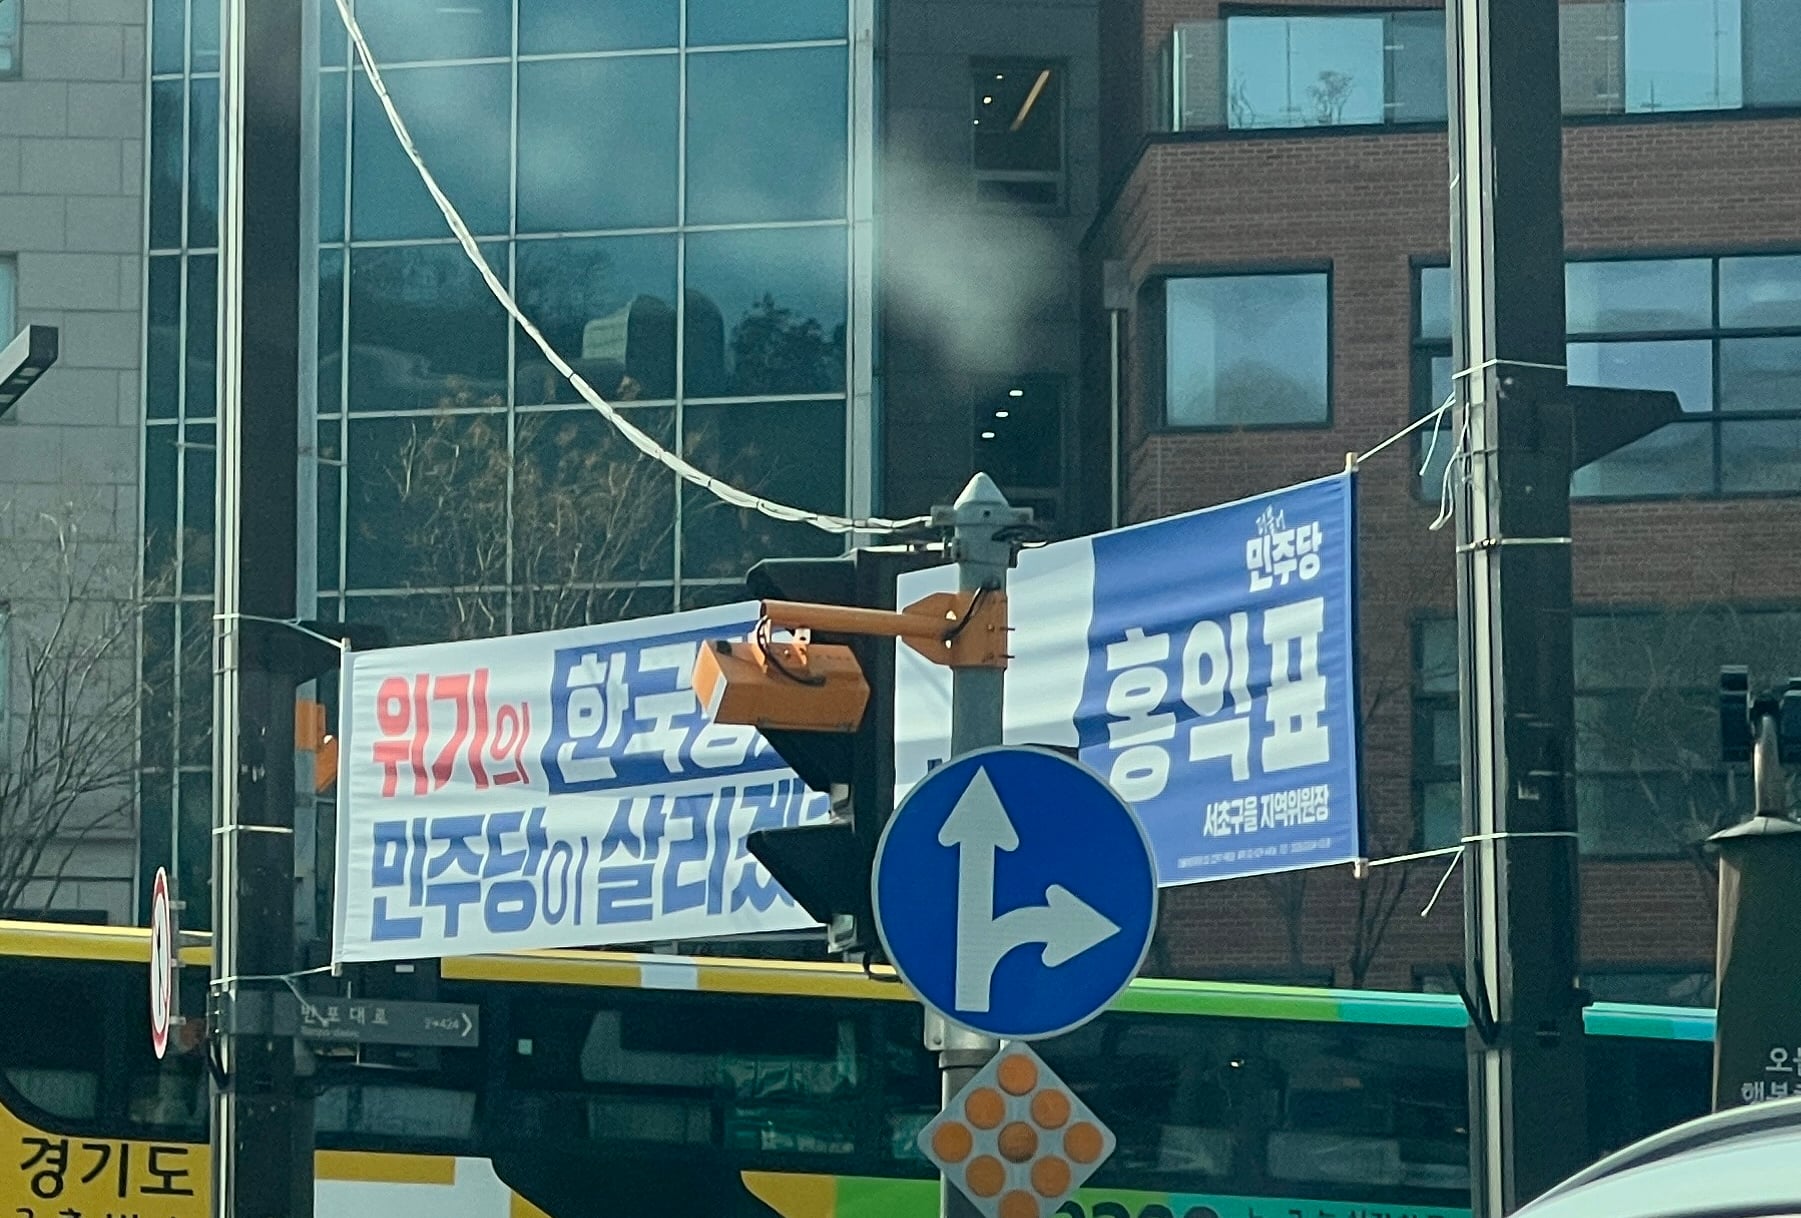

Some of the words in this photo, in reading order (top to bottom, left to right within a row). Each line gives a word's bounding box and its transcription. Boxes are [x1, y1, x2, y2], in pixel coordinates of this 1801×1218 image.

[1246, 520, 1323, 593] 민주당
[373, 668, 530, 798] 위기의
[1106, 597, 1330, 802] 홍익표
[1203, 796, 1258, 837] 서초구을
[1261, 784, 1330, 829] 지역위원장
[371, 806, 588, 943] 민주당이
[301, 1004, 389, 1025] 반포대로
[19, 1137, 195, 1199] 경기도
